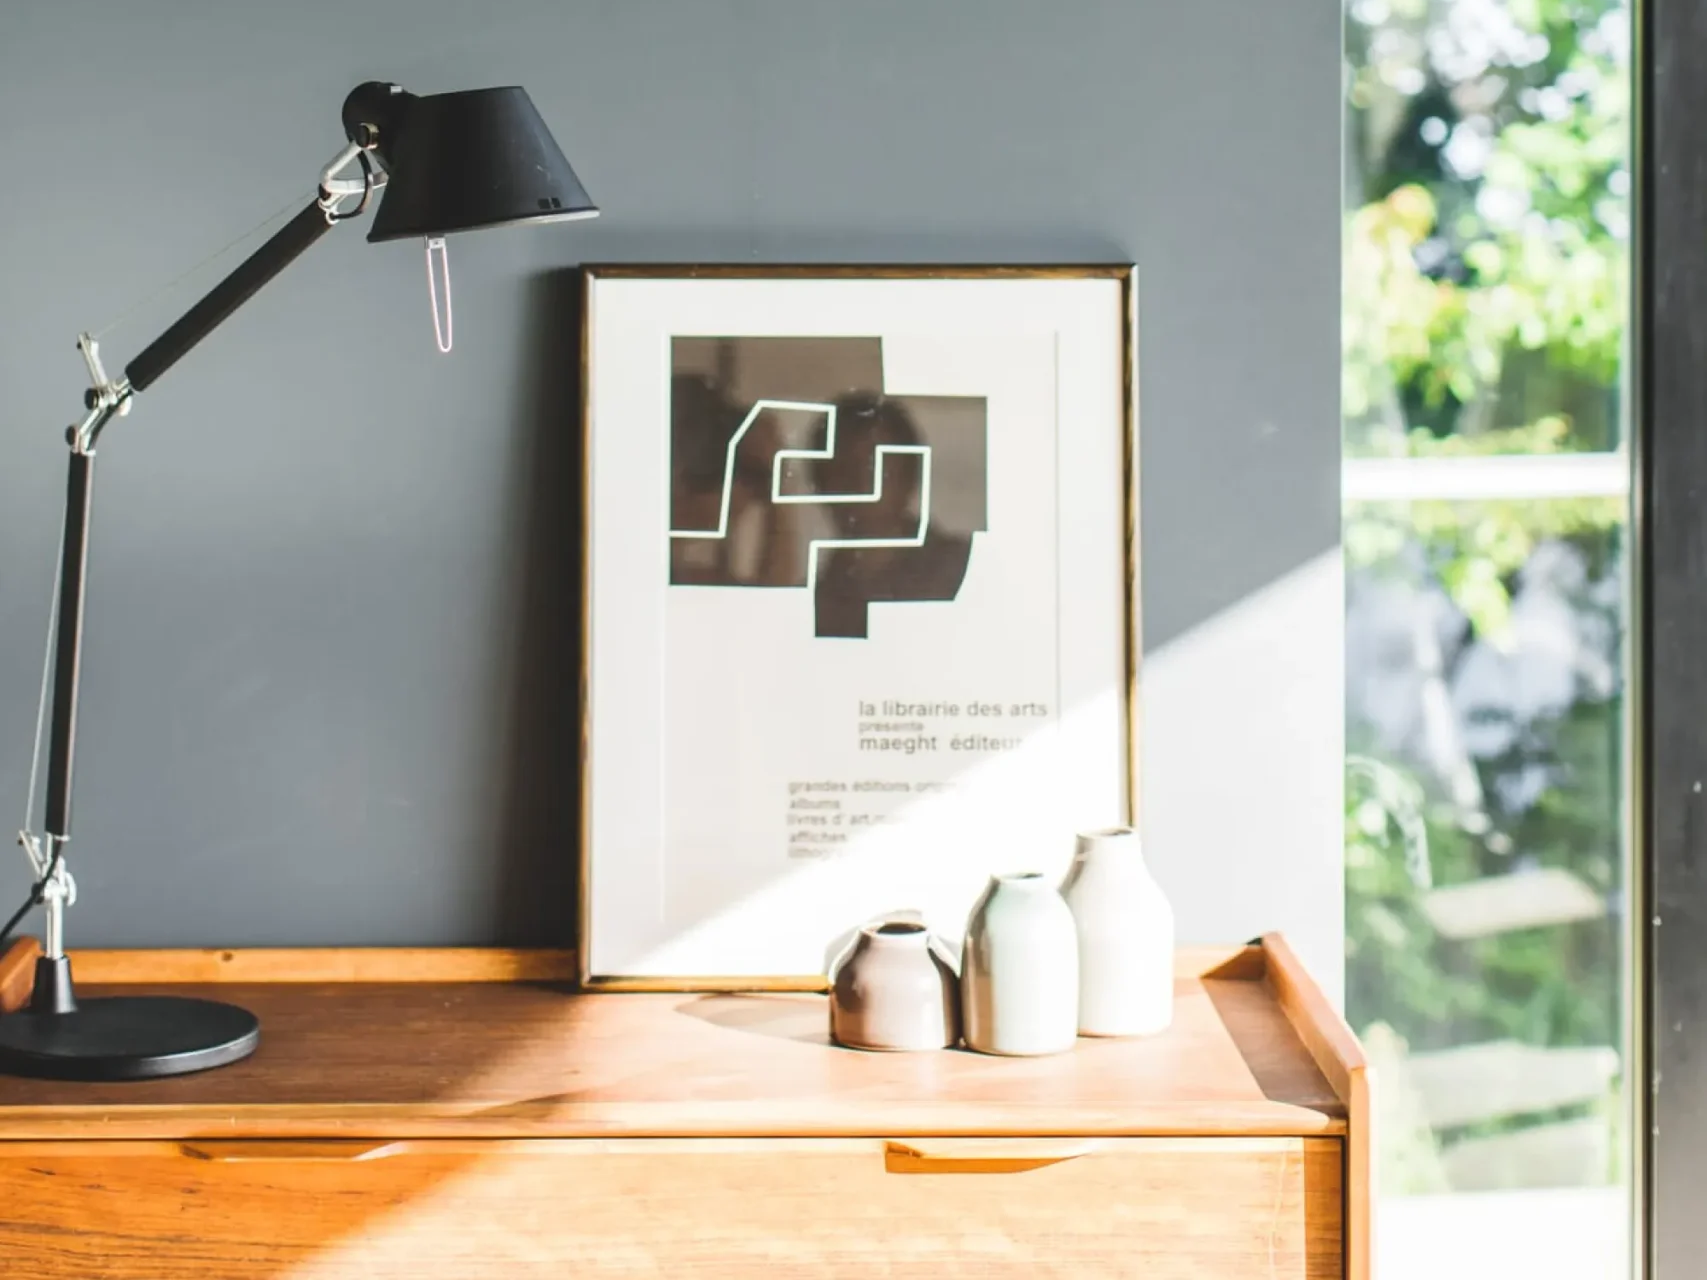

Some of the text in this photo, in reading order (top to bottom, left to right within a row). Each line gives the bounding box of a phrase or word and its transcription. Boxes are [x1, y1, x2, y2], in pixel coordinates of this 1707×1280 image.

[859, 700, 1048, 717] la librairie des arts
[859, 734, 938, 754] maeght
[788, 781, 847, 795] grandes
